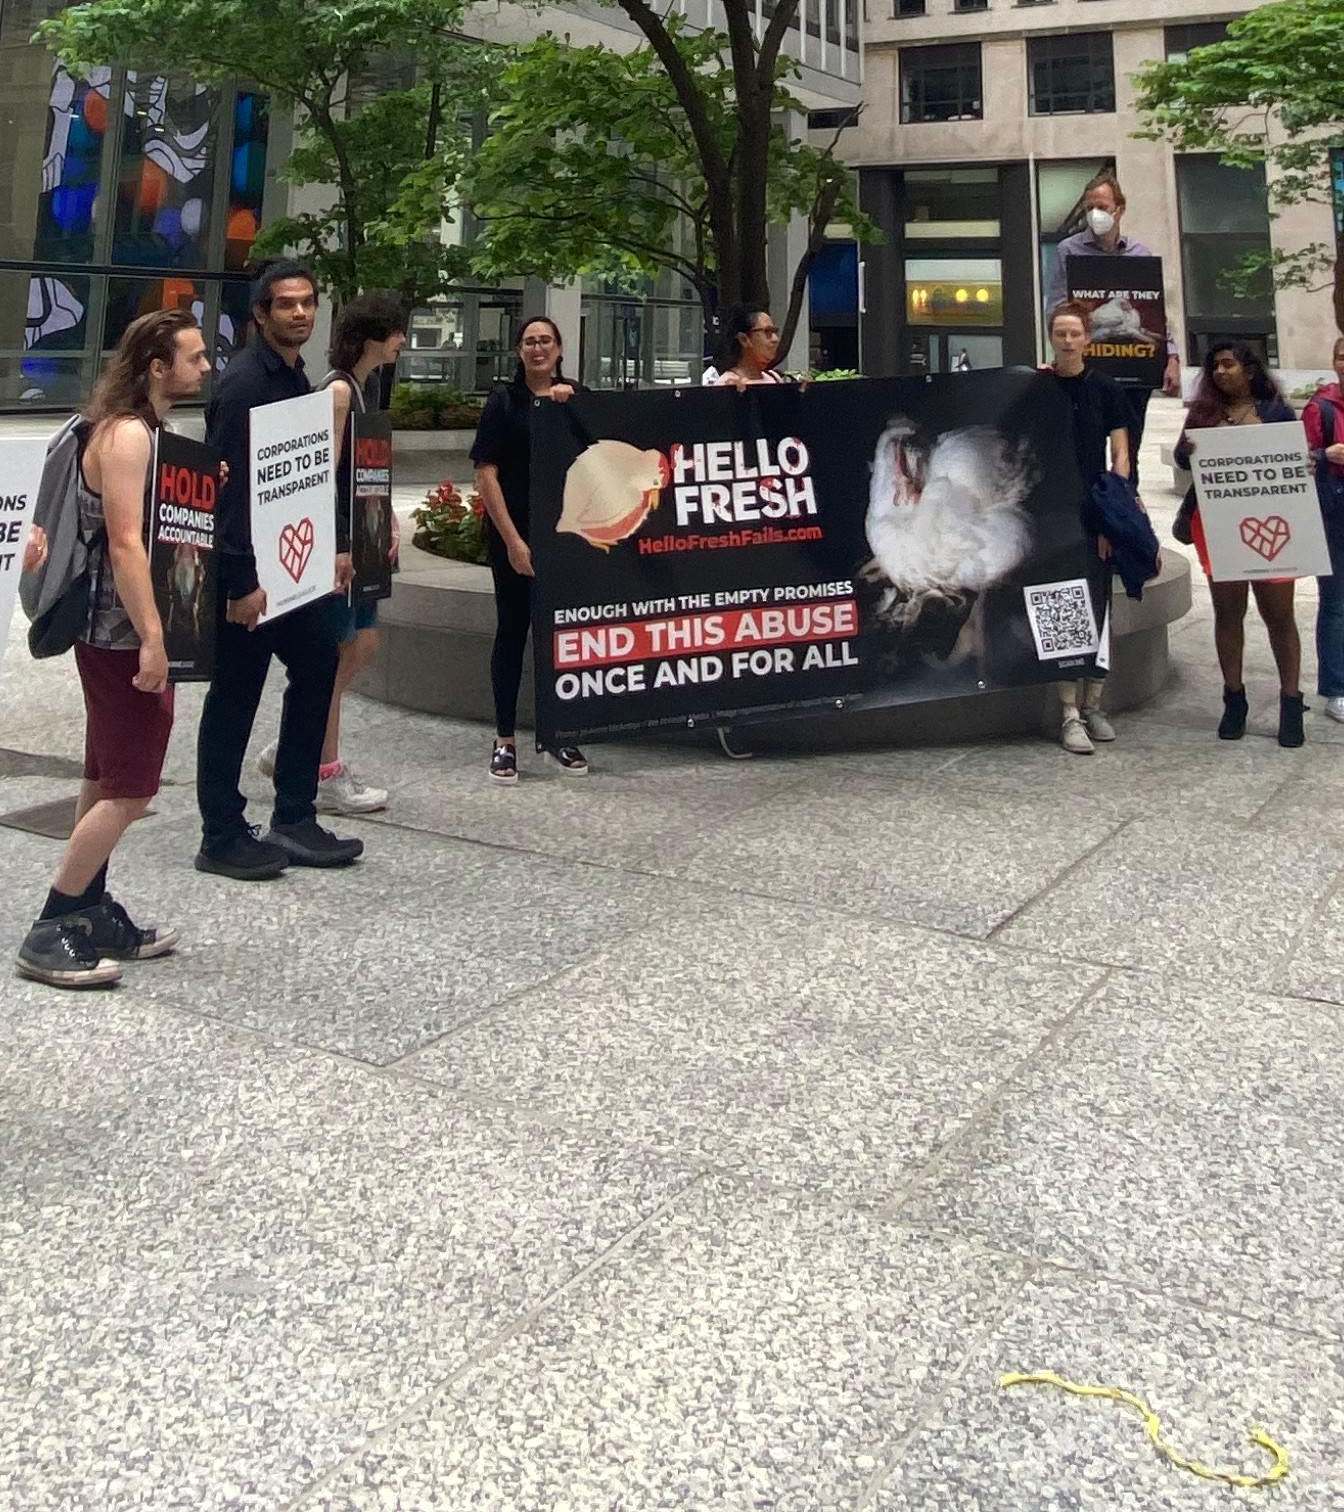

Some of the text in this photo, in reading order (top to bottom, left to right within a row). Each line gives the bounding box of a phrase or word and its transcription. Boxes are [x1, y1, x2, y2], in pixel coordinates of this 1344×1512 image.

[1072, 289, 1161, 300] WHAT ARE THEY
[1084, 343, 1155, 358] HIDING?
[257, 429, 329, 462] CORPORATIONS
[673, 436, 809, 484] HELLO
[1199, 452, 1303, 468] CORPORATIONS
[257, 447, 330, 486] NEED TO BE
[1201, 466, 1306, 485] NEED TO BE
[159, 462, 216, 509] HOLD
[257, 469, 330, 506] TRANSPARENT
[674, 476, 818, 526] FRESH
[1205, 482, 1308, 500] TRANSPARENT
[159, 502, 215, 531] COMPANIES
[158, 524, 214, 549] ACCOUNTABLE
[638, 525, 824, 555] HelloFreshFails.com
[554, 580, 854, 624] ENOUGH WITH THE EMPTY PROMISES
[557, 603, 854, 663] END THIS ABUSE
[555, 641, 859, 700] ONCE AND FOR ALL
